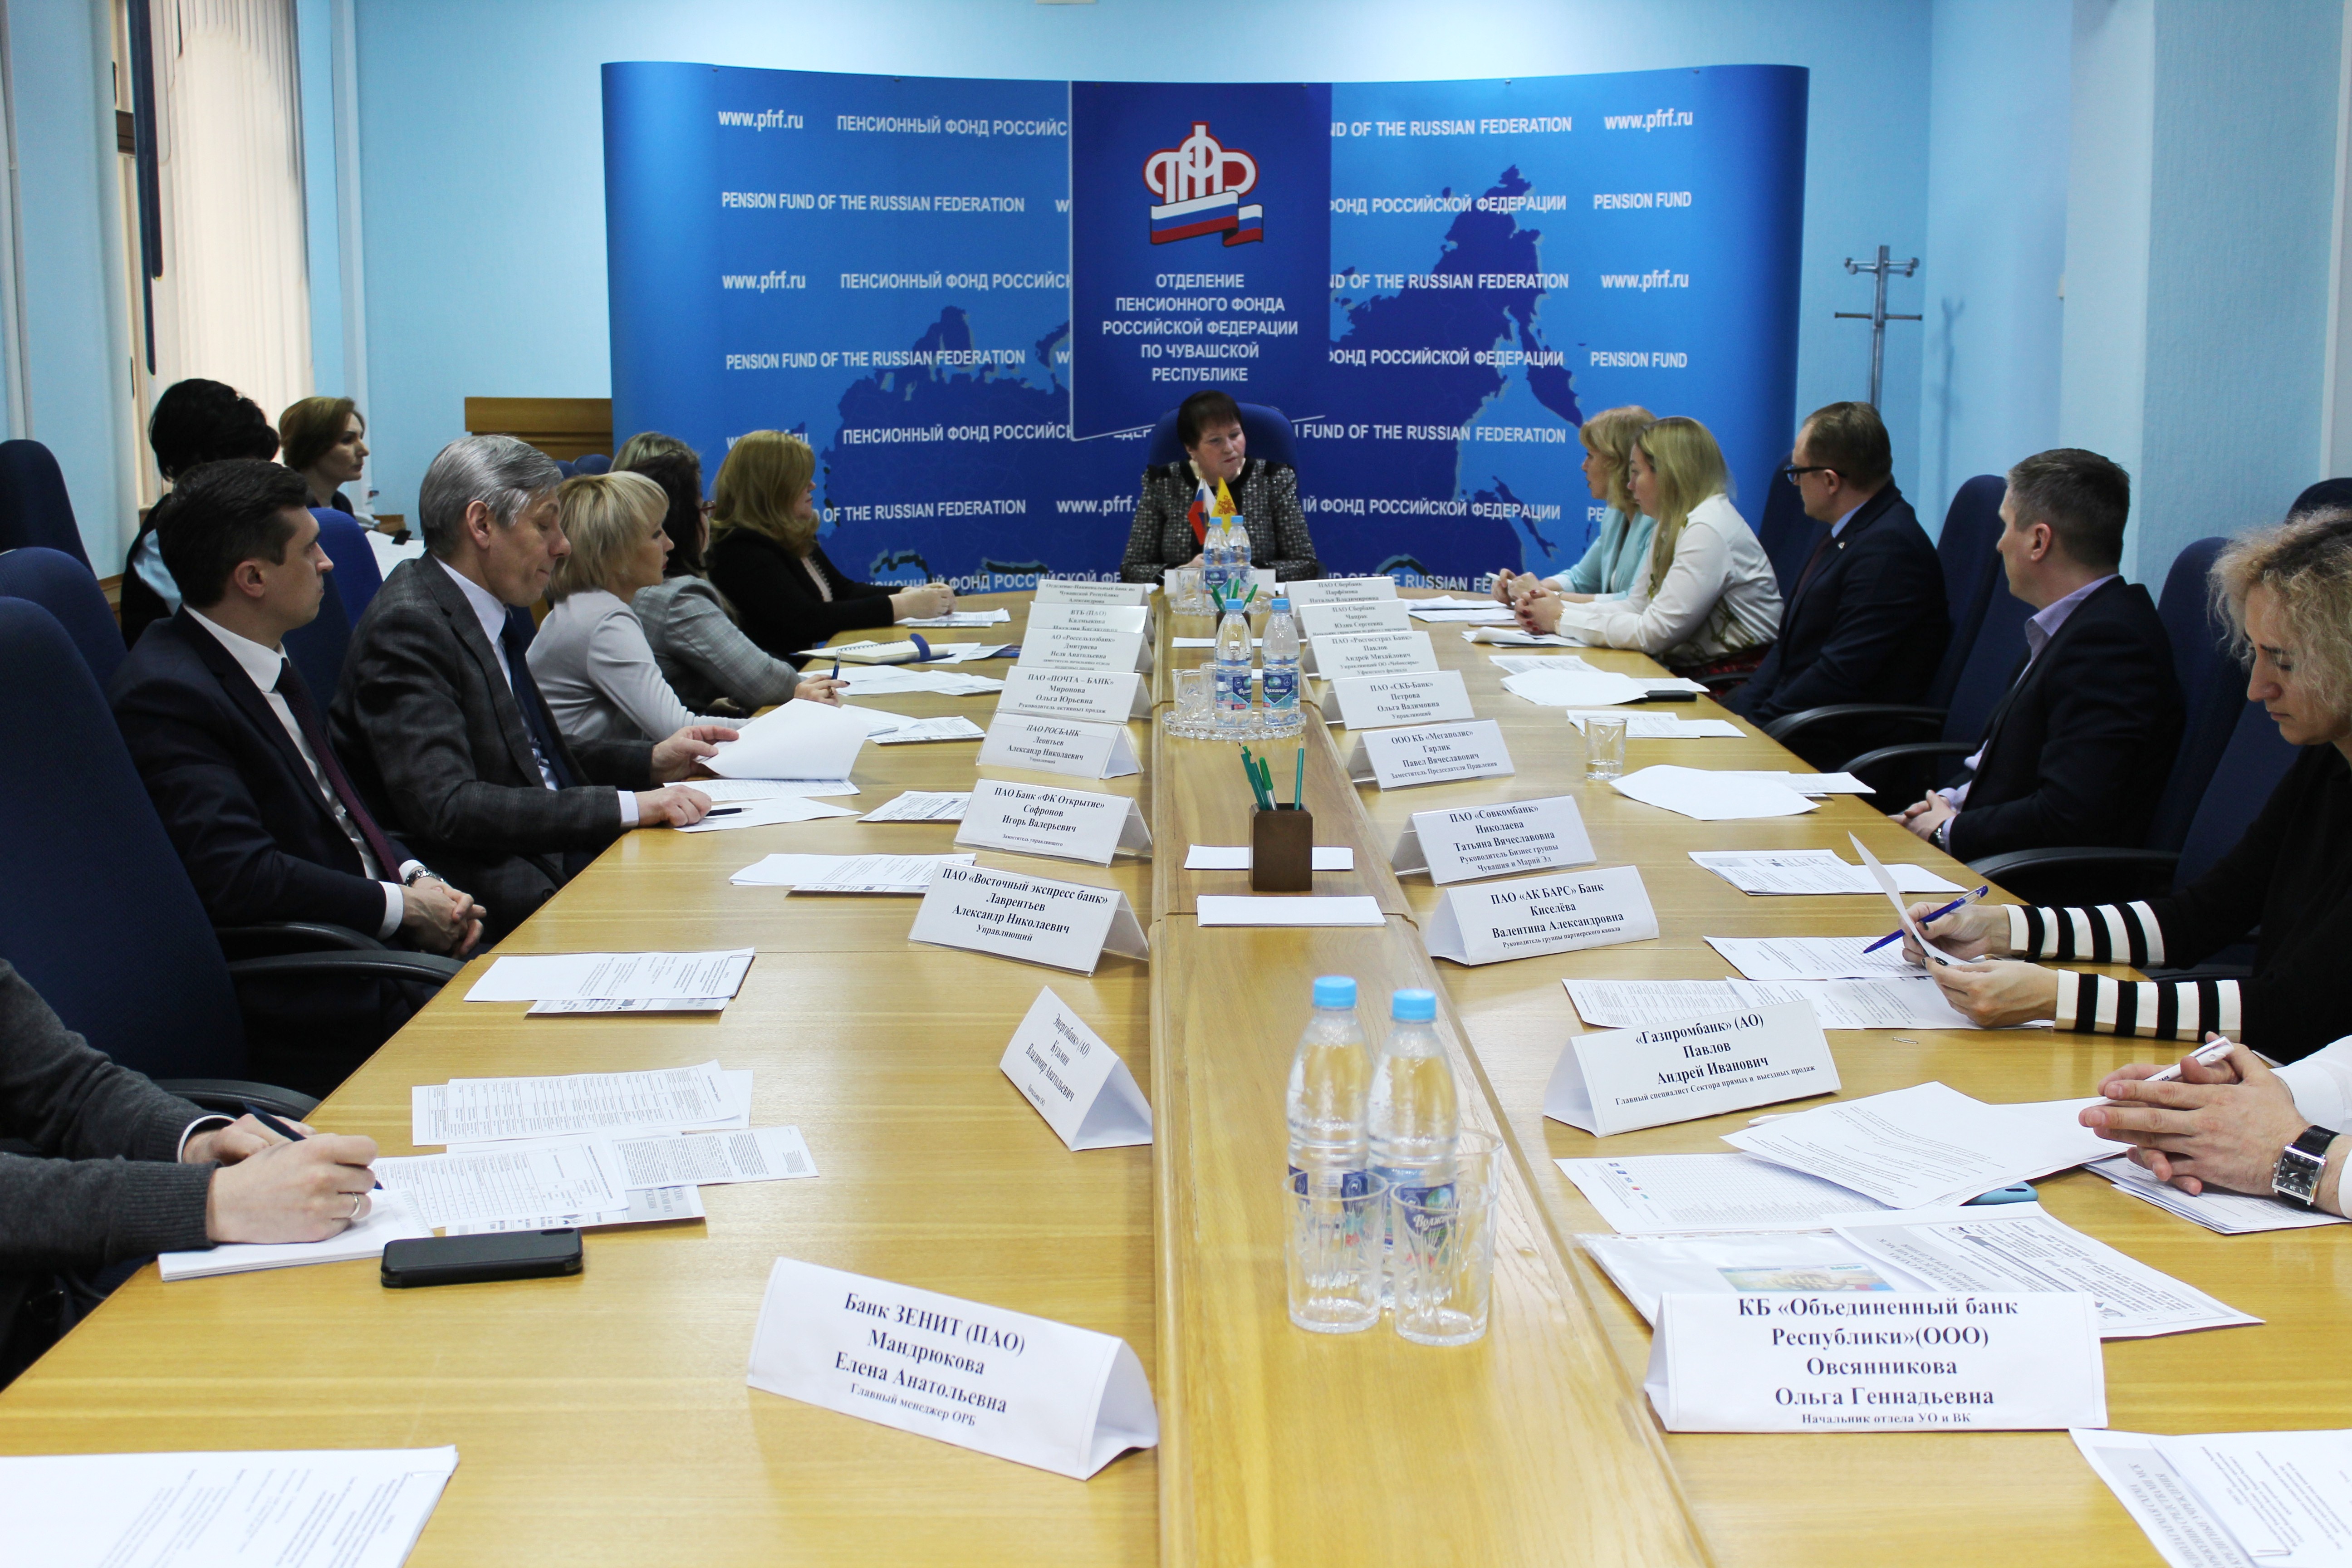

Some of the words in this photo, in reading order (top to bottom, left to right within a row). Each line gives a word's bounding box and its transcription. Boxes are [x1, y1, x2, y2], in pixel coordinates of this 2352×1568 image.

[718, 109, 803, 132] www.pfrf.ru
[837, 115, 941, 133] ПЕНСИОННЫЙ
[945, 119, 990, 137] ФОНД
[993, 118, 1068, 136] РОССИЙС
[1351, 121, 1372, 137] OF
[1375, 121, 1406, 136] THE
[1410, 119, 1475, 136] RUSSIAN
[1480, 116, 1572, 134] FEDERATION
[1604, 108, 1693, 132] www.pfrf.ru
[1372, 194, 1472, 213] РОССИЙСКОЙ
[1476, 195, 1567, 214] ФЕДЕРАЦИИ
[1594, 192, 1653, 209] PENSION
[1656, 191, 1692, 208] FUND
[722, 270, 806, 293] www.pfrf.ru
[1156, 274, 1245, 290] ОТДЕЛЕНИЕ
[1116, 297, 1228, 311] ПЕНСИОННОГО
[1231, 297, 1285, 314] ФОНДА
[1102, 318, 1203, 335] РОССИЙСКОЙ
[1207, 320, 1298, 337] ФЕДЕРАЦИИ
[1141, 343, 1162, 358] ПО
[1166, 341, 1259, 358] ЧУВАШСКОЙ
[726, 353, 779, 370] PENSION
[782, 352, 817, 368] FUND
[820, 352, 839, 368] OF
[842, 351, 869, 367] THE
[872, 351, 932, 366] RUSSIAN
[936, 349, 1025, 365] FEDERATION
[1152, 367, 1248, 382] РЕСПУБЛИКЕ
[1056, 495, 1140, 516] www.pfrf.
[1320, 498, 1365, 516] ФОНД
[1369, 497, 1467, 516] РОССИЙСКОЙ
[1471, 502, 1561, 522] ФЕДЕРАЦИИ
[1050, 685, 1086, 694] Миронова
[1059, 696, 1093, 705] Юрьевна
[1401, 702, 1440, 710] Вадимовна
[1392, 711, 1431, 720] Управляющий
[1026, 724, 1044, 732] ПАО
[1044, 726, 1081, 737] РОСБАНК
[1391, 736, 1411, 744] ООО
[1411, 734, 1424, 742] КБ
[1033, 736, 1064, 746] Леонтьев
[1422, 745, 1451, 754] Гарлик
[1006, 745, 1042, 756] Александр
[1043, 748, 1083, 760] Николаевич
[1402, 760, 1426, 768] Павел
[1427, 754, 1479, 764] Вячеславович
[1390, 770, 1427, 779] Заместитель
[1427, 765, 1466, 775] Председателя
[1466, 762, 1498, 770] Правления
[995, 787, 1014, 797] ПАО
[1015, 790, 1036, 800] Банк
[1023, 804, 1063, 817] Софронов
[1449, 812, 1472, 823] ПАО
[1475, 806, 1539, 819] «Совкомбанк»
[1002, 815, 1026, 827] Игорь
[1028, 818, 1077, 832] Валерьевич
[1475, 822, 1524, 834] Николаева
[1453, 841, 1492, 852] Татьяна
[1493, 832, 1555, 846] Вячеславовна
[1460, 852, 1508, 865] Руководитель
[1533, 845, 1559, 854] группы
[1477, 863, 1509, 873] Чувашия
[1516, 858, 1541, 867] Марий
[942, 868, 967, 881] ПАО
[969, 873, 1029, 892] «Восточный
[1031, 885, 1075, 899] экспресс
[1077, 890, 1108, 904] банк»
[1490, 892, 1516, 905] ПАО
[1519, 889, 1541, 900] «АК
[1542, 886, 1576, 898] БАРС»
[1578, 884, 1604, 894] Банк
[986, 892, 1045, 911] Лаврентьев
[1530, 903, 1576, 916] Киселёва
[952, 905, 1004, 924] Александр
[1006, 913, 1070, 934] Николаевич
[1492, 924, 1546, 938] Валентина
[1549, 911, 1624, 932] Александровна
[976, 924, 1033, 941] Управляющий
[1503, 939, 1541, 949] Руководитель
[1542, 935, 1563, 944] группы
[1563, 930, 1601, 940] партнерского
[1635, 1022, 1732, 1044] «Газпромбанк»
[1734, 1014, 1764, 1031] (АО)
[1682, 1042, 1731, 1058] Павлов
[1657, 1065, 1705, 1085] Андрей
[1706, 1057, 1769, 1076] Иванович
[1615, 1094, 1649, 1106] Главный
[1649, 1088, 1689, 1100] специалист
[1690, 1082, 1721, 1093] Сектора
[1721, 1077, 1749, 1088] прямых
[1756, 1070, 1790, 1081] выездных
[1790, 1065, 1816, 1076] продаж
[1739, 1298, 1771, 1316] КБ
[1778, 1298, 1958, 1318] «Объединенный
[1965, 1297, 2018, 1315] банк
[844, 1292, 890, 1319] Банк
[893, 1304, 962, 1337] ЗЕНИТ
[966, 1323, 1025, 1357] (ПАО)
[867, 1328, 985, 1375] Мандрюкова
[1806, 1357, 1957, 1375] Овсянникова
[835, 1351, 888, 1382] Елена
[893, 1368, 1007, 1413] Анатольевна
[850, 1382, 898, 1405] Главный
[899, 1398, 950, 1421] менеджер
[952, 1411, 975, 1426] ОРБ
[1775, 1387, 1844, 1406] Ольга
[1851, 1387, 1994, 1406] Геннадьевна
[1802, 1413, 1871, 1424] Начальник
[1918, 1413, 1938, 1423] УО
[1953, 1412, 1971, 1423] ВК
